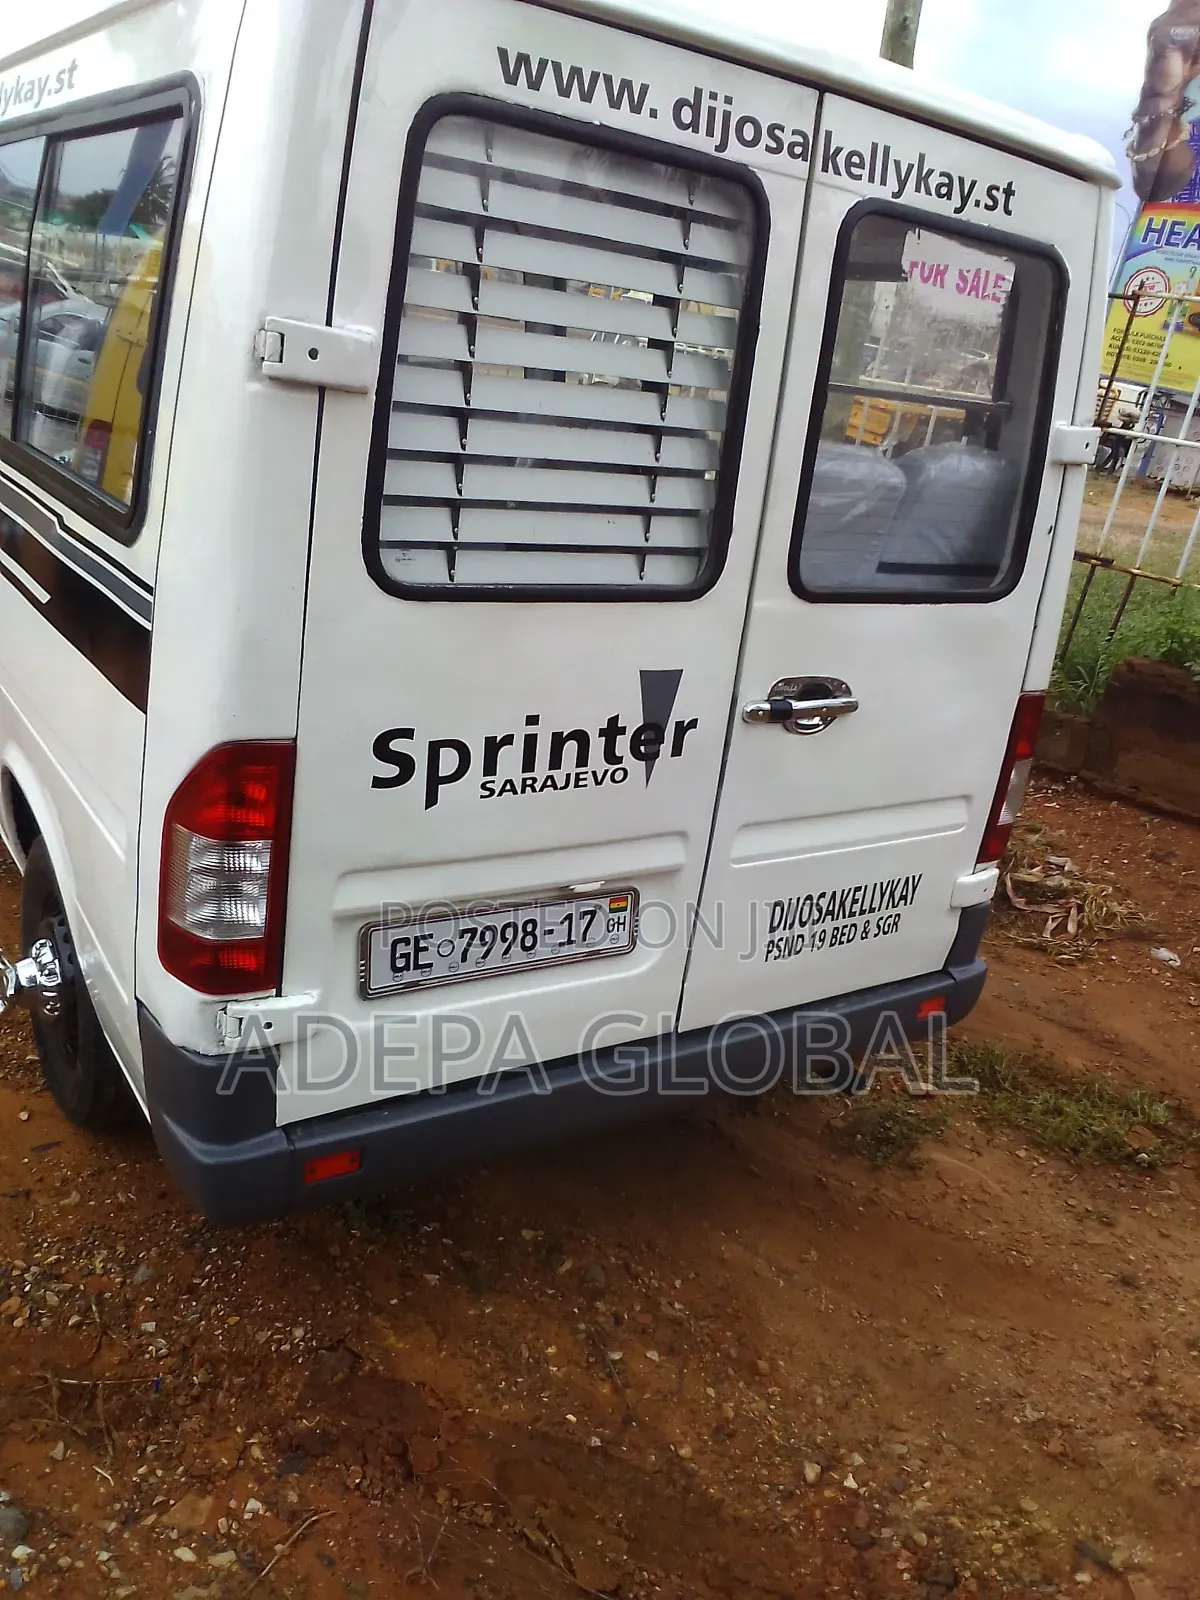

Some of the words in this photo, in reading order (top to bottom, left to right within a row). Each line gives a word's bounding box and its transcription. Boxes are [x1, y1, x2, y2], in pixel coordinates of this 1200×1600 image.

[497, 47, 658, 118] www.
[956, 267, 1006, 303] SALE
[370, 713, 698, 811] Sprinter
[479, 767, 628, 799] SARAJEVO
[607, 915, 627, 934] GH
[768, 873, 922, 934] DIJOSAKELLYKAY
[390, 933, 434, 973] GE
[458, 909, 599, 963] 7998-17
[765, 935, 804, 962] PSND
[810, 928, 826, 952] 19
[829, 922, 856, 948] BED
[860, 919, 870, 940] &
[873, 912, 901, 938] SGR
